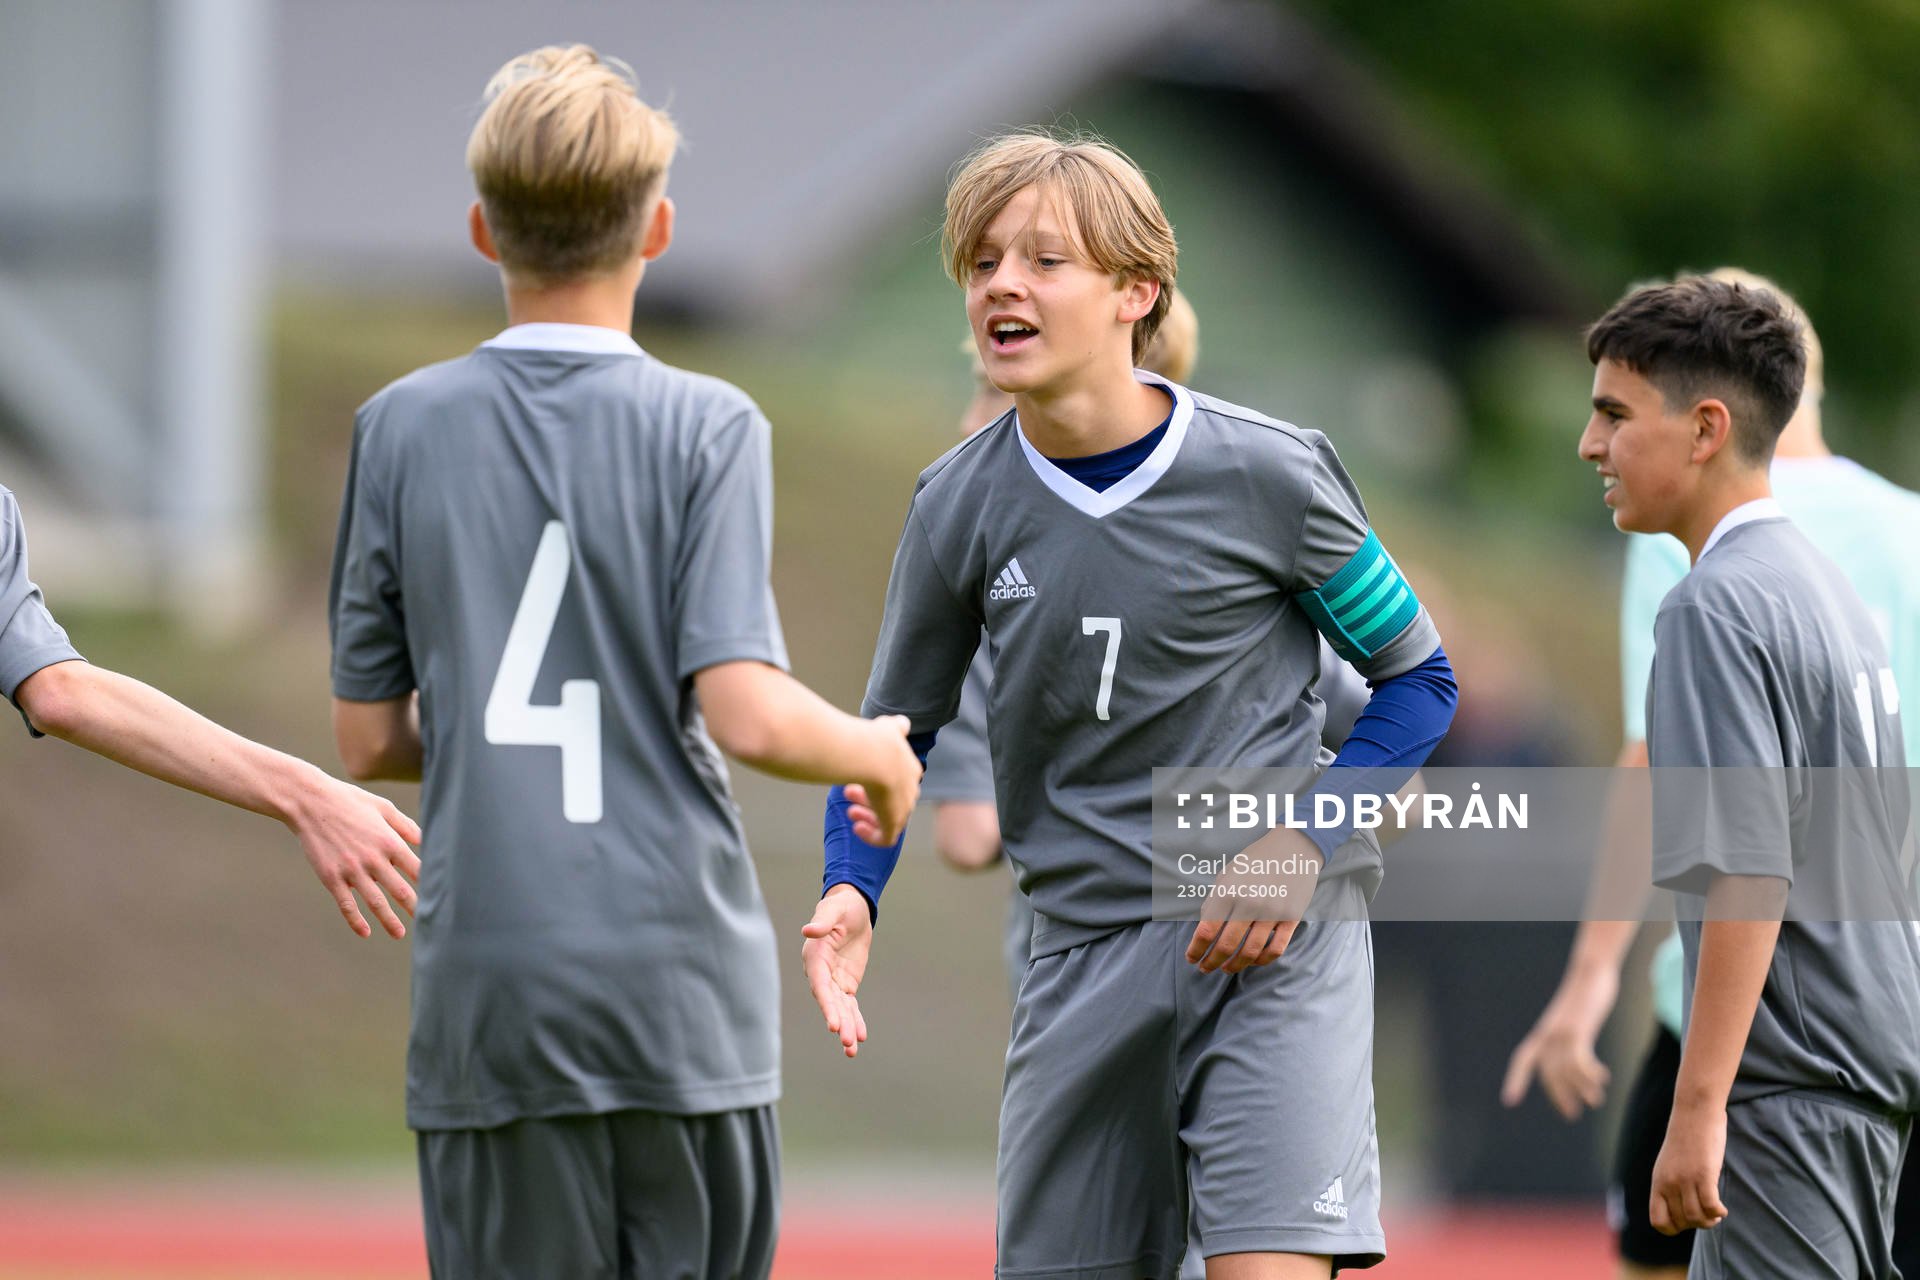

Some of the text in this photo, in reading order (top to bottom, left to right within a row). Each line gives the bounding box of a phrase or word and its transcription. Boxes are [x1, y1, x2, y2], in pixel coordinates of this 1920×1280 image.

[990, 585, 1036, 600] adidas
[484, 519, 603, 824] 4
[1082, 617, 1122, 720] 7
[1313, 1200, 1348, 1218] adidas
